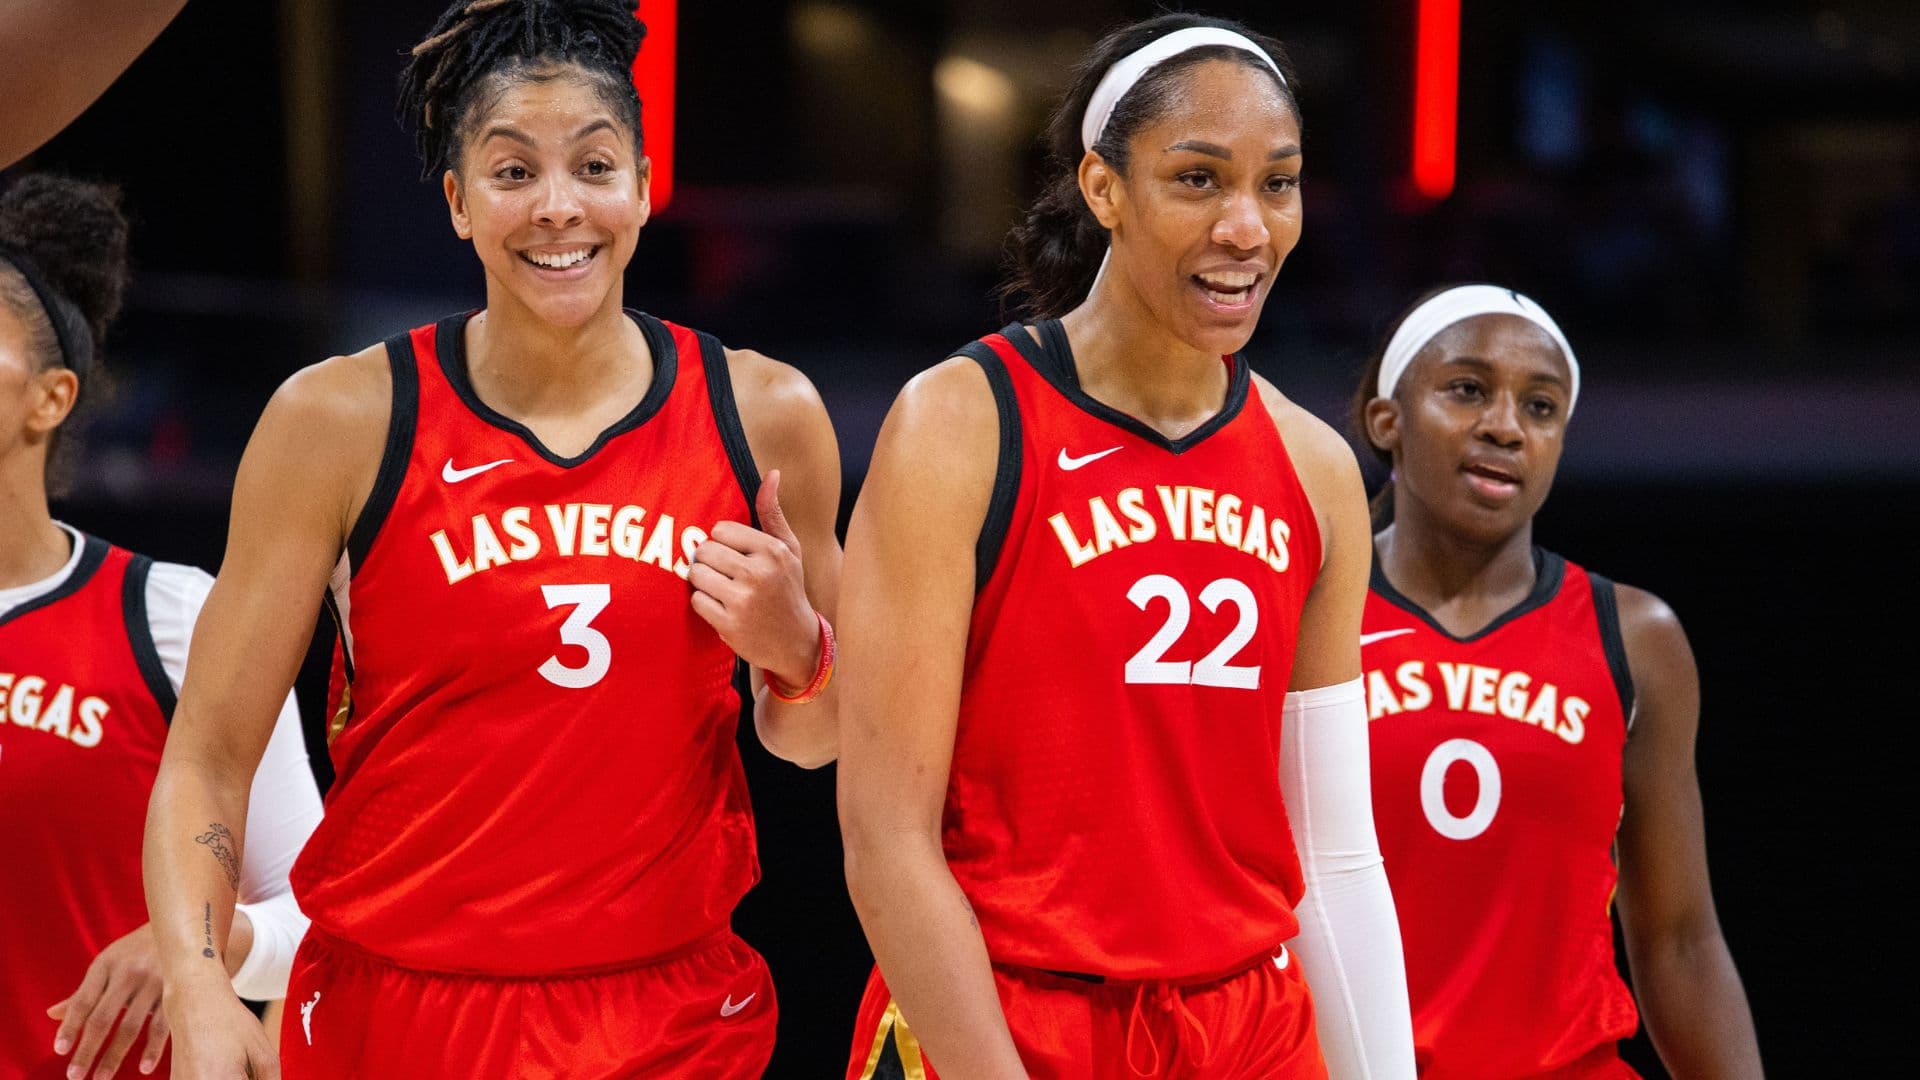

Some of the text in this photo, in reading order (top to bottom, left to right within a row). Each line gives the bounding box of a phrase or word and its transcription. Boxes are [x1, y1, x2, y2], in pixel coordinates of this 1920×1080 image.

[429, 503, 709, 585] LAS VEGAS
[1048, 485, 1291, 573] LAS VEGAS
[536, 583, 612, 689] 3
[1124, 574, 1262, 690] 22
[1367, 660, 1591, 744] AS VEGAS
[1420, 738, 1502, 840] 0
